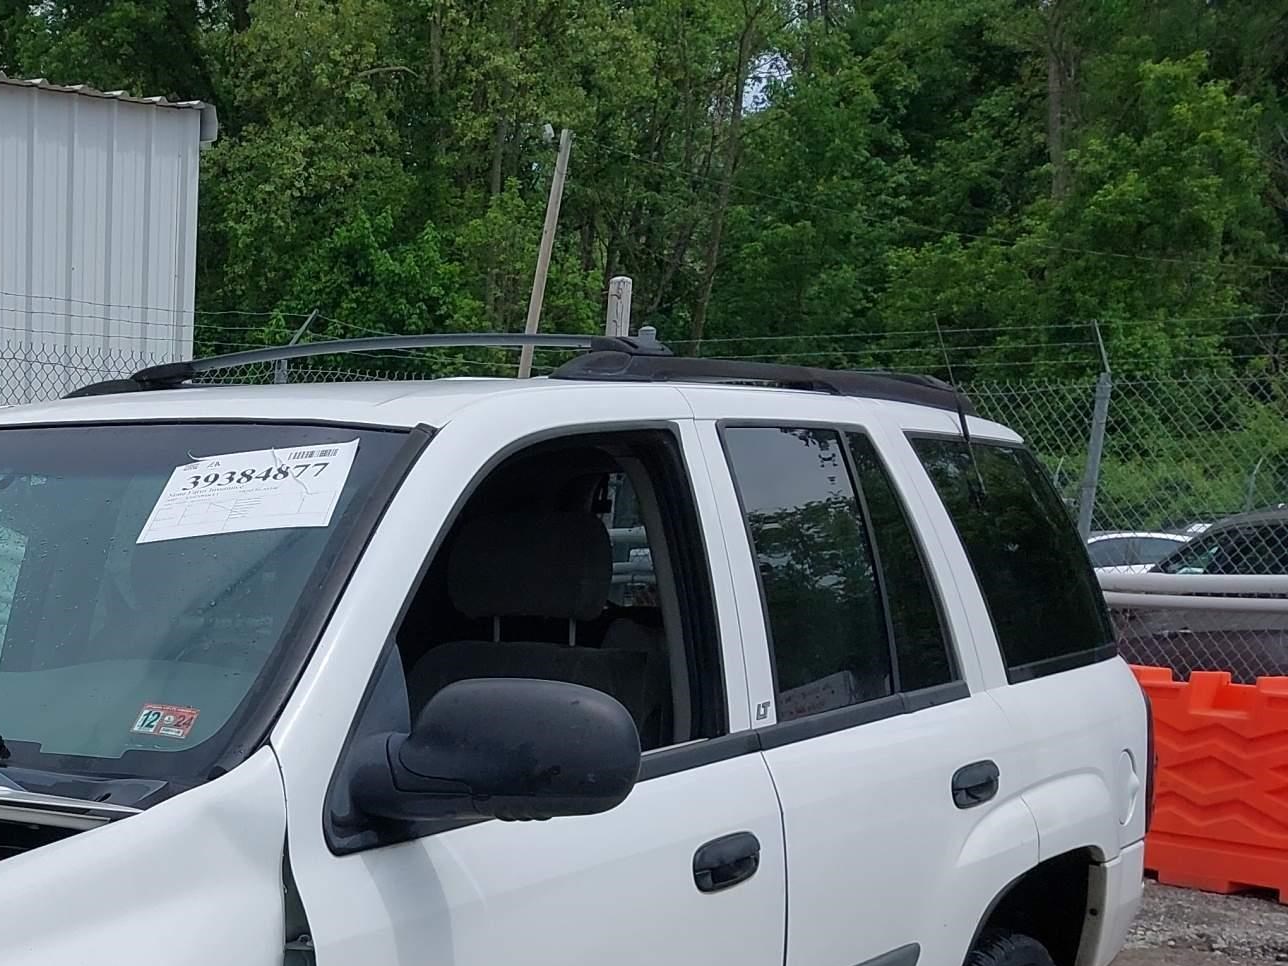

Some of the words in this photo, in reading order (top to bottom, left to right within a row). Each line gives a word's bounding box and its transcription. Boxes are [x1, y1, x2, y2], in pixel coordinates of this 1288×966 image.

[182, 462, 329, 491] 39384877
[140, 710, 161, 728] 12
[756, 700, 771, 721] LT
[174, 715, 194, 729] 24
